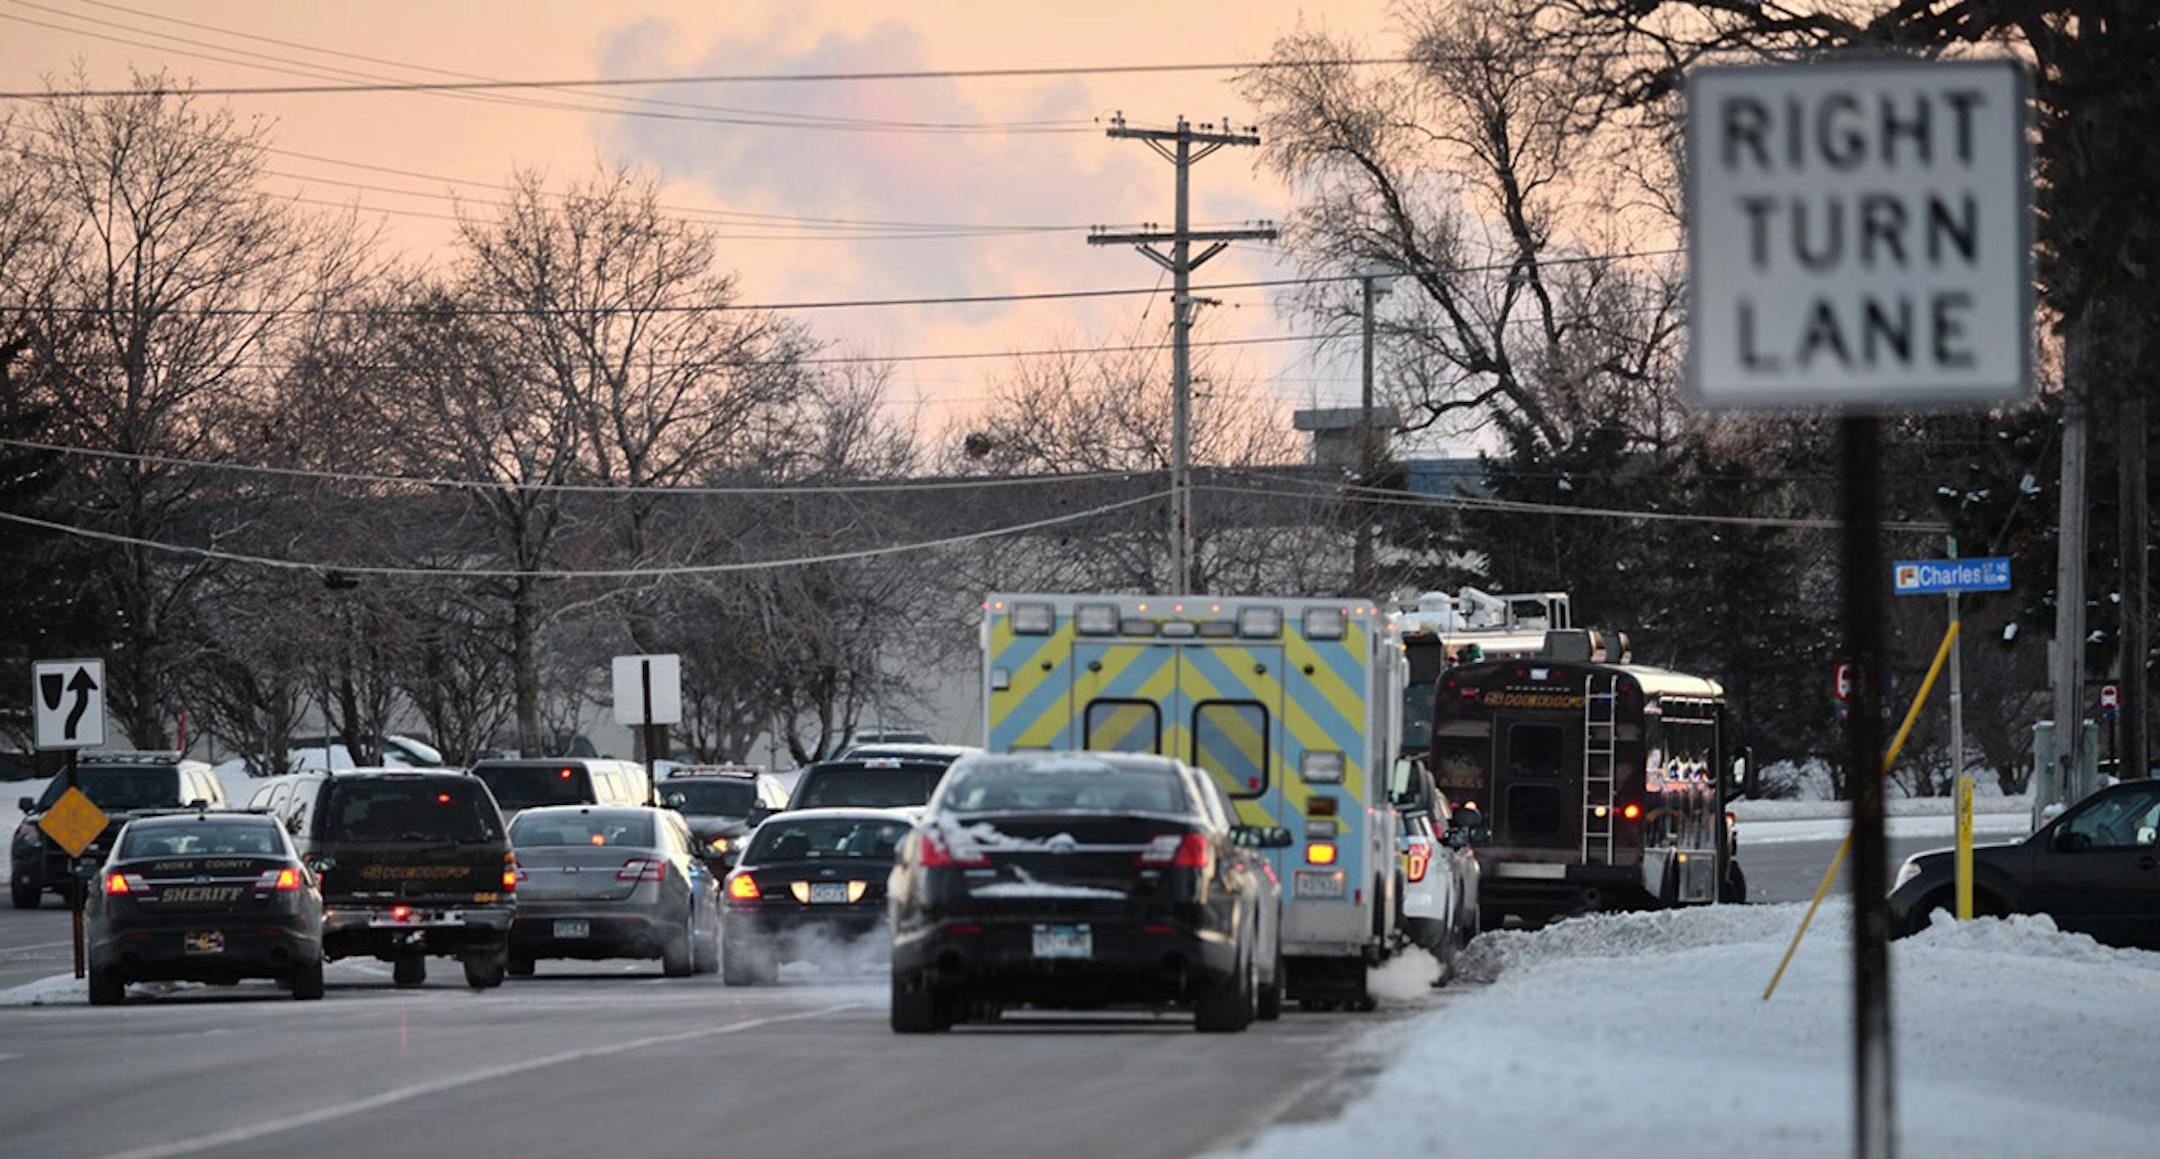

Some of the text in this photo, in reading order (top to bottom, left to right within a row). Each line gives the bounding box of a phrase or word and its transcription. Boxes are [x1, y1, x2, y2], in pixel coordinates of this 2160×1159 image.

[1722, 89, 1987, 170] RIGHT
[1737, 194, 1979, 271] TURN
[1738, 292, 1975, 373] LANE
[1919, 565, 1982, 586] Charles
[154, 859, 252, 872] ANOKA COUNTY
[161, 887, 244, 902] SHERIFF
